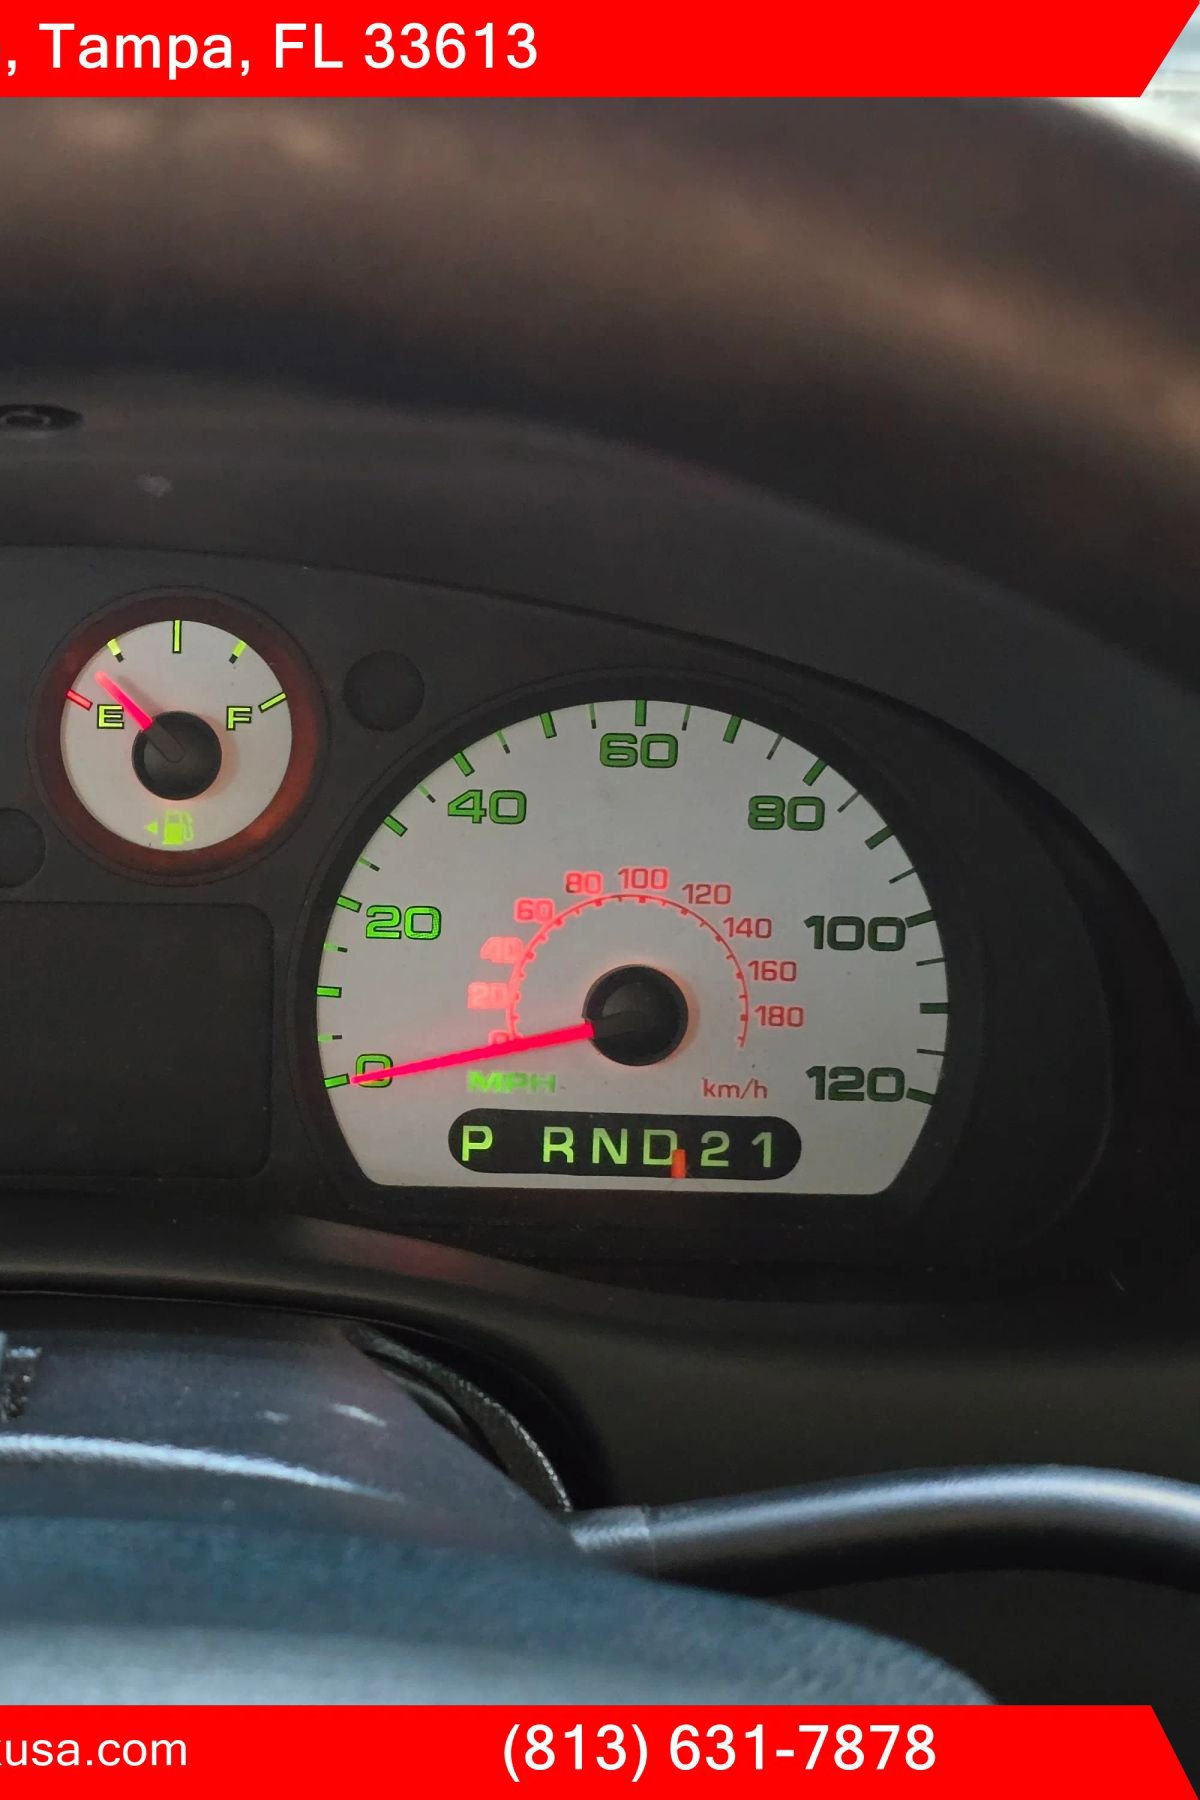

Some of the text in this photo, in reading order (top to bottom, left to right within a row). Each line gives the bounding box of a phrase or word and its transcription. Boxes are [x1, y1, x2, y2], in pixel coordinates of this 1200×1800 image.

[96, 704, 125, 728] E
[226, 705, 253, 729] F
[599, 732, 679, 769] 60
[447, 789, 527, 824] 40
[747, 795, 826, 832] 80
[566, 871, 603, 894] 80
[618, 868, 668, 890] 100
[682, 882, 732, 906] 120
[515, 898, 554, 922] 60
[365, 905, 442, 941] 20
[723, 917, 773, 939] 140
[804, 914, 907, 952] 100
[748, 961, 798, 983] 160
[468, 982, 509, 1008] 20
[754, 1005, 804, 1029] 180
[355, 1053, 394, 1089] 0
[467, 1071, 556, 1094] MPH
[703, 1077, 768, 1099] km/h
[806, 1066, 906, 1103] 120
